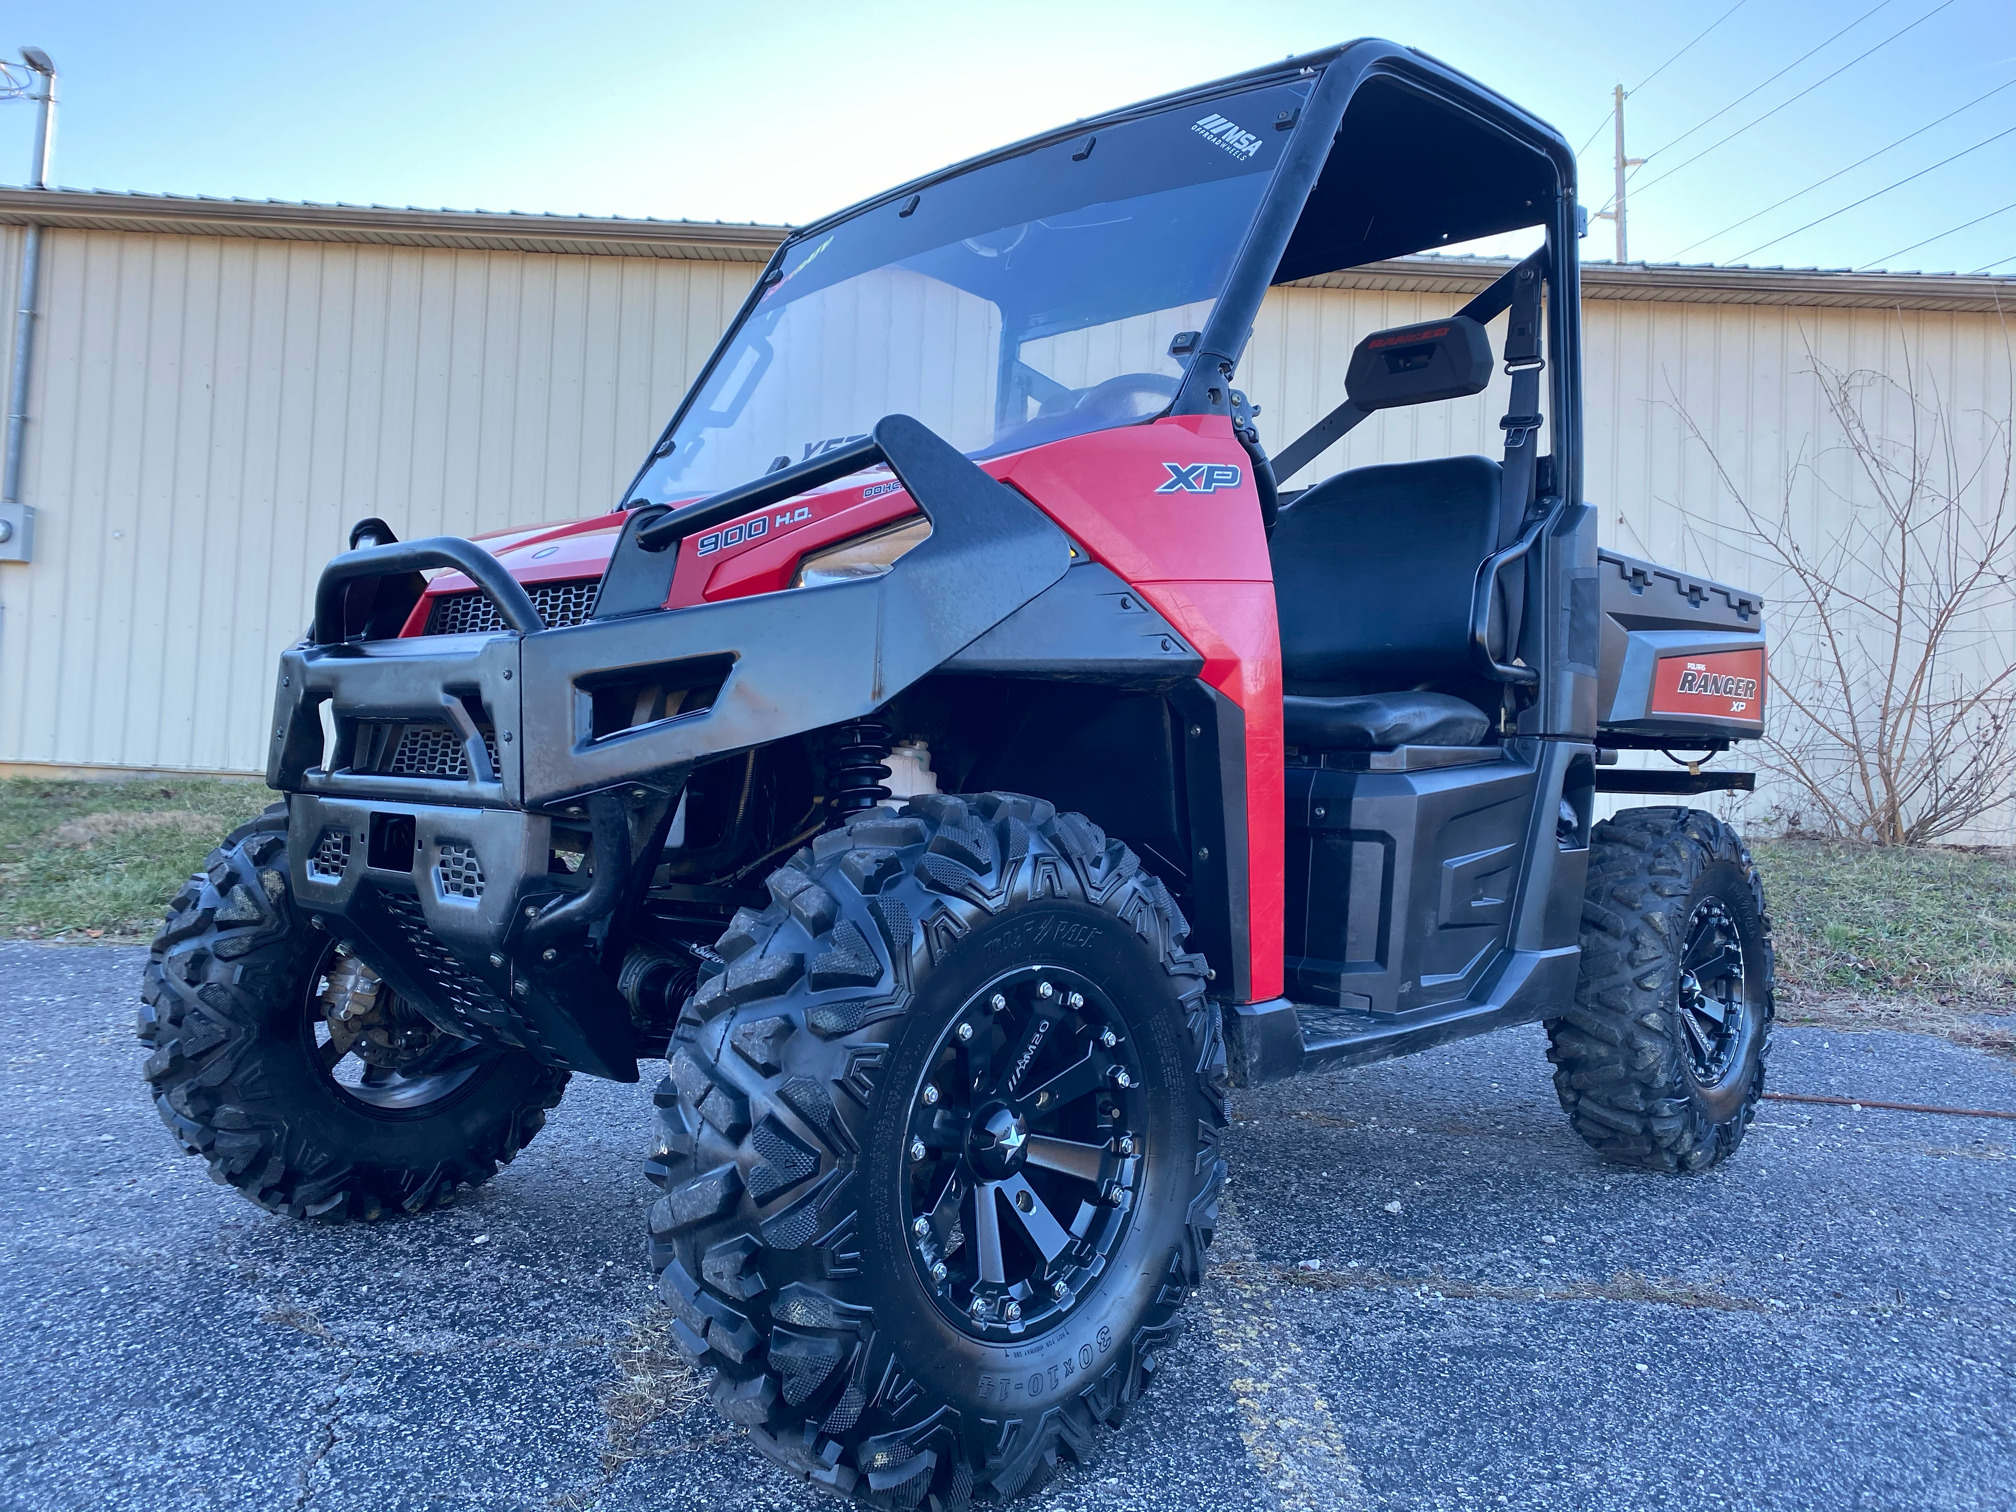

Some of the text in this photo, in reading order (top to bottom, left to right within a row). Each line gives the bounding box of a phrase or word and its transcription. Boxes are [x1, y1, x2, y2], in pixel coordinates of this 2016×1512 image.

[1153, 462, 1243, 495] XP
[697, 506, 813, 557] 900 H.O.
[1677, 670, 1757, 700] RANGER
[1730, 701, 1746, 712] XP
